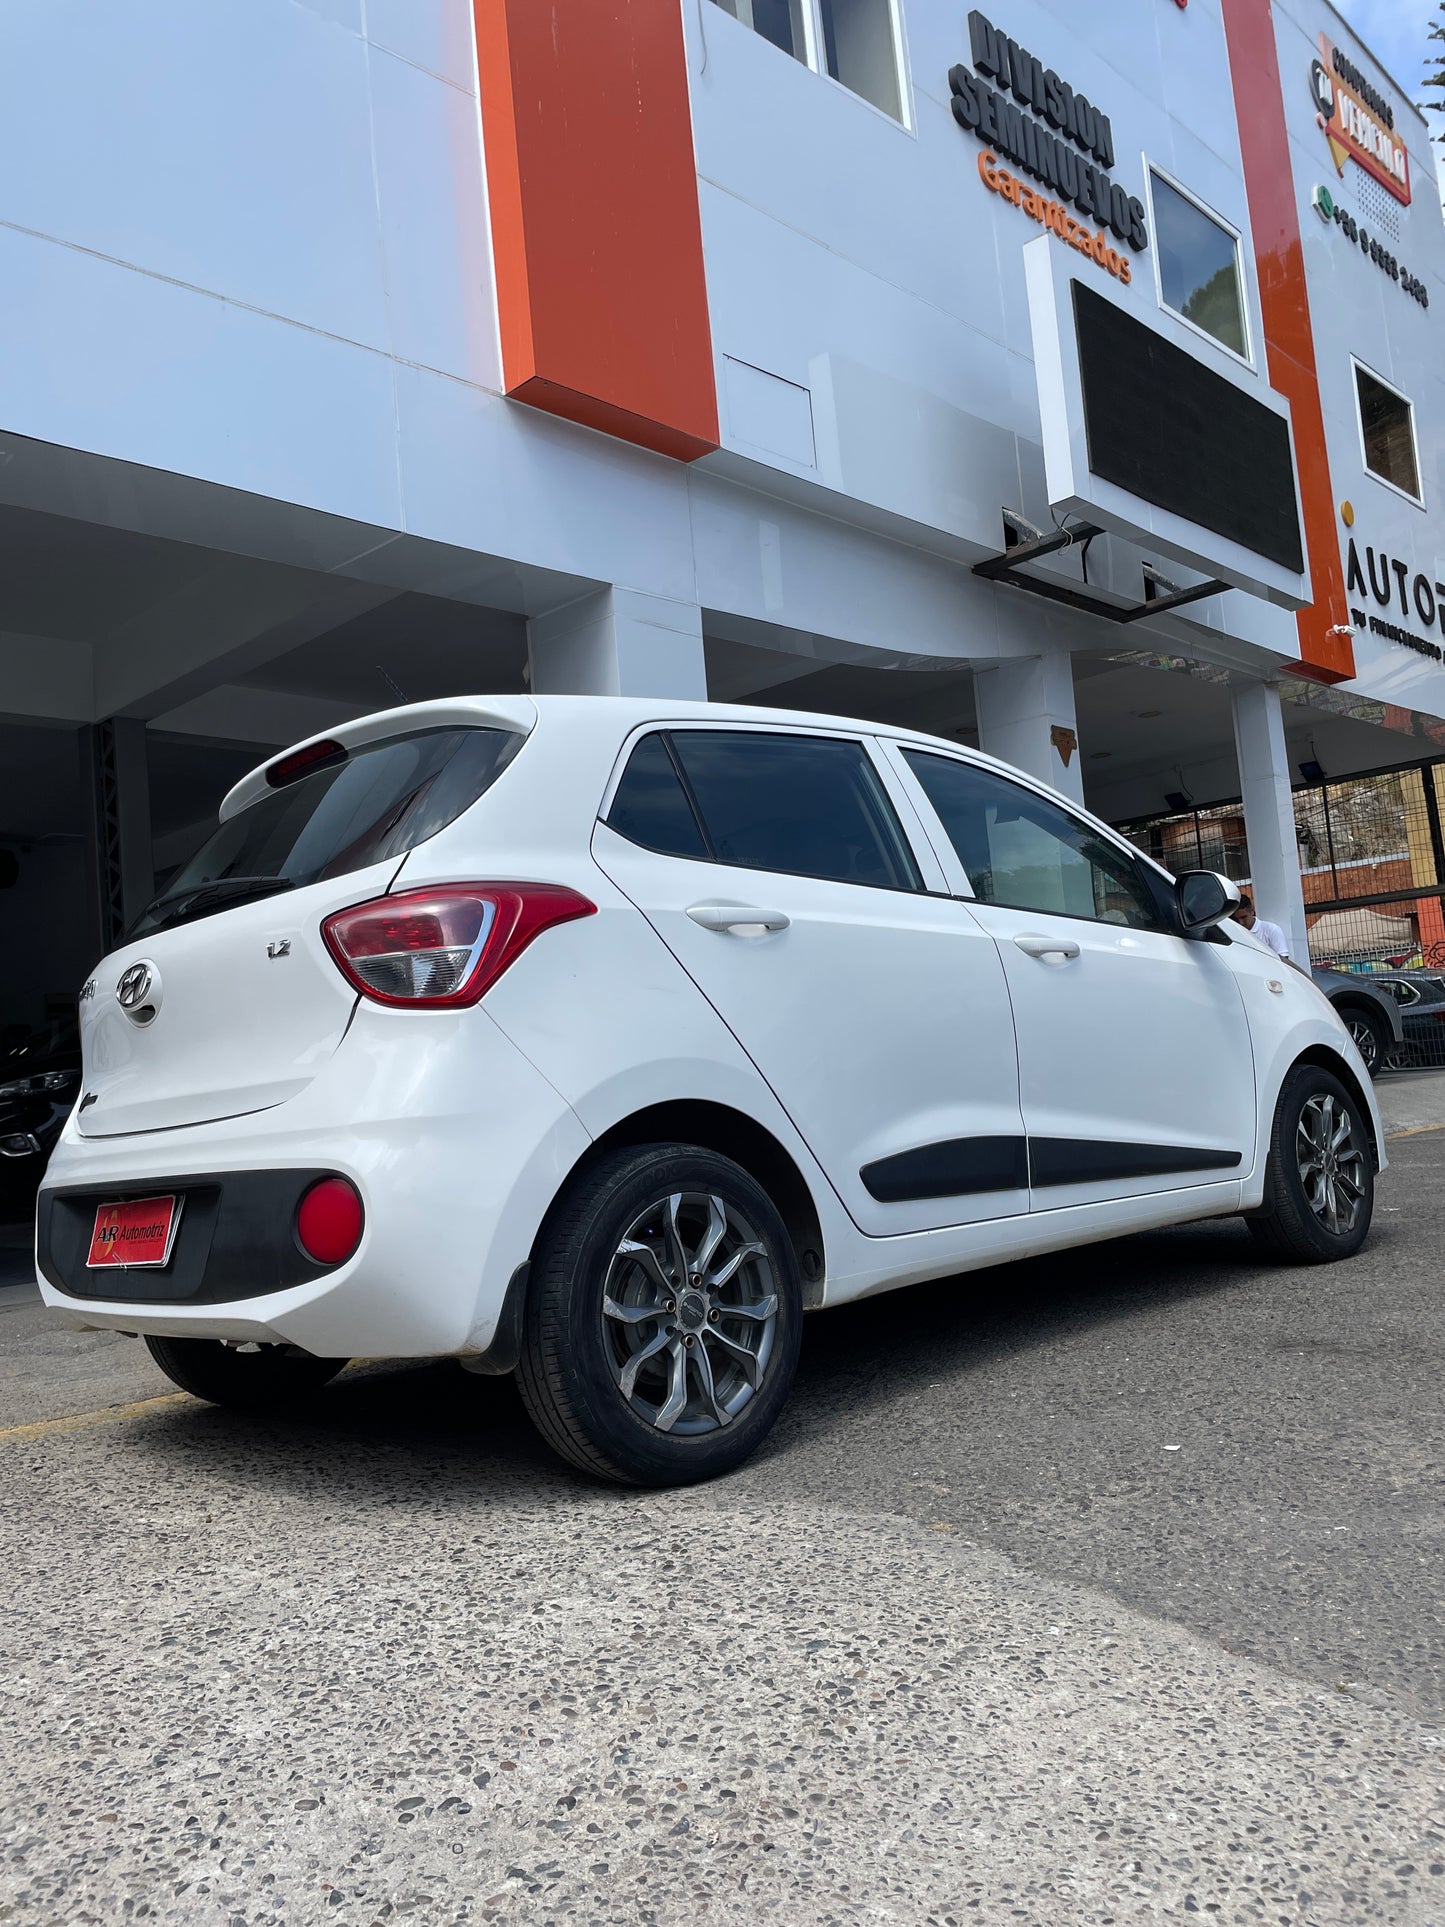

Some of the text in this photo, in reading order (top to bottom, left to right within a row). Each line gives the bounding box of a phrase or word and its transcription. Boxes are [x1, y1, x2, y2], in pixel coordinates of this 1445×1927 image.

[968, 9, 1115, 169] DIVISION
[948, 63, 1148, 253] SEMINUEVOS
[978, 148, 1132, 284] Garantizados
[1347, 537, 1445, 634] AUTO
[266, 939, 291, 960] 1.2
[119, 1220, 165, 1240] Automotriz
